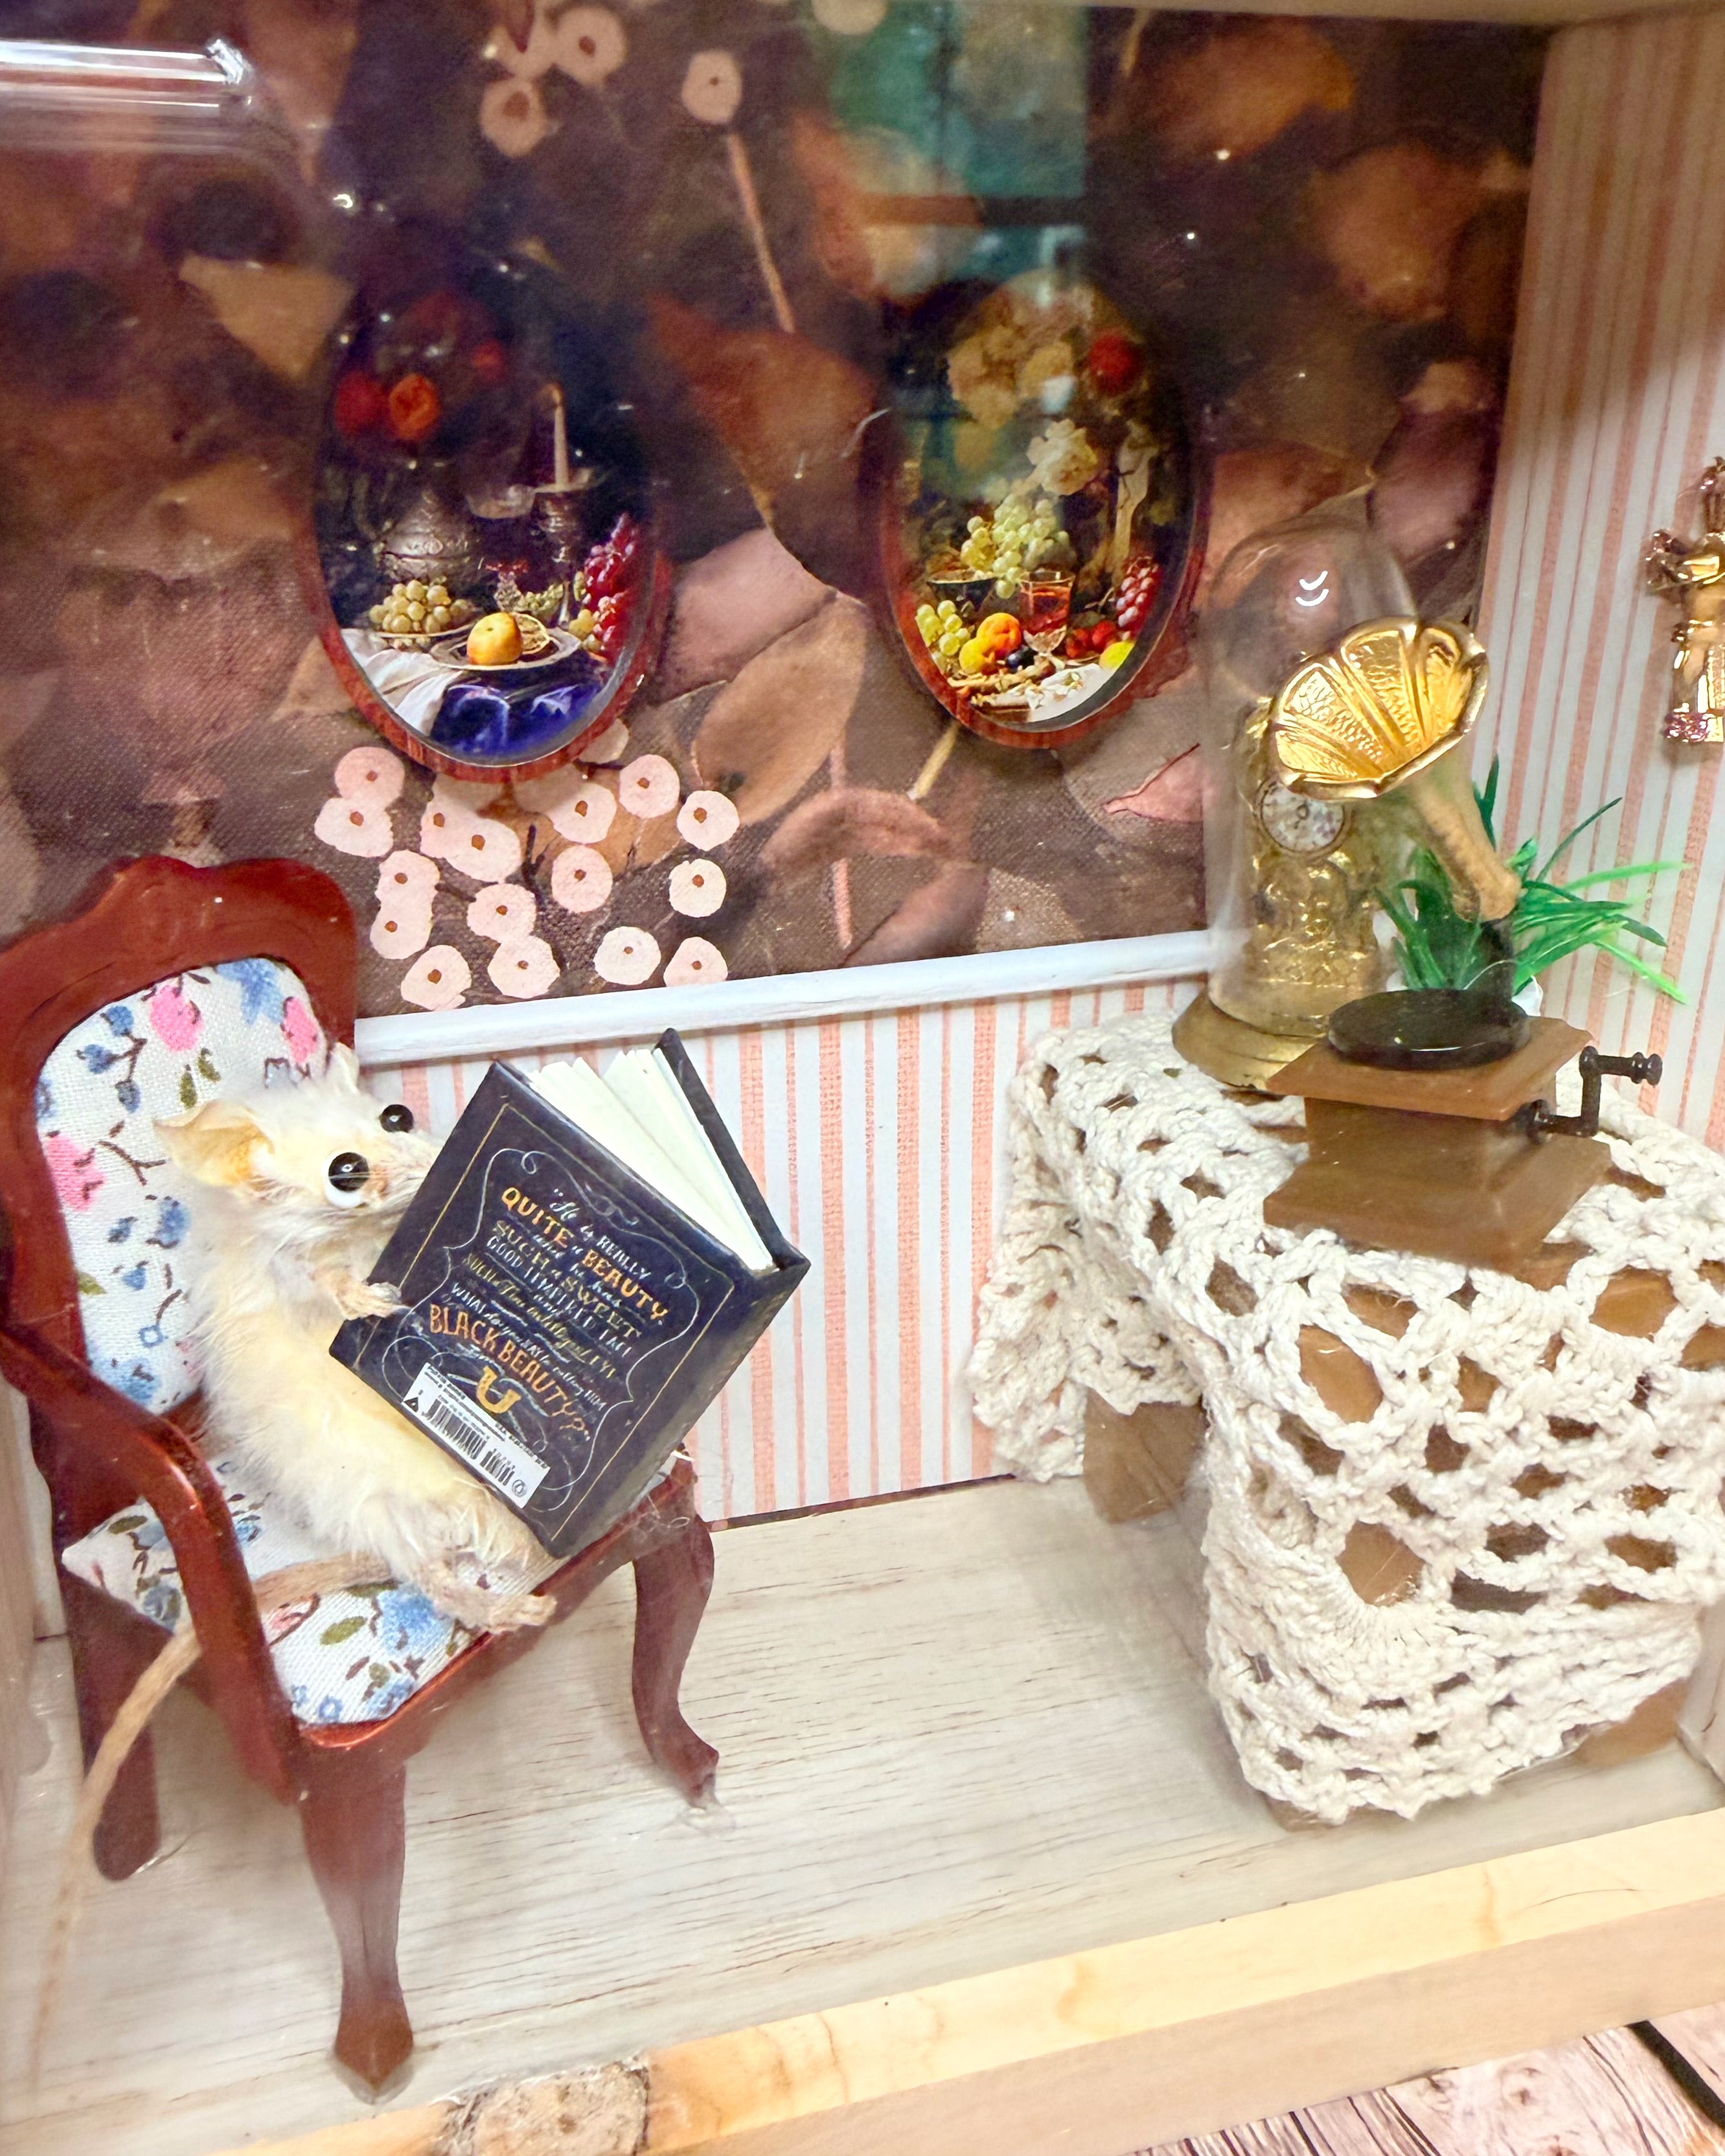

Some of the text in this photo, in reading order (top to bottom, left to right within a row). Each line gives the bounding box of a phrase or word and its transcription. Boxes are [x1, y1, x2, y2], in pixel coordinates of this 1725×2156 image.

[501, 1186, 575, 1249] QUITE
[486, 1235, 522, 1267] GOOD
[595, 1235, 651, 1279] REALLY
[492, 1220, 549, 1270] SUCH
[559, 1276, 641, 1337] SWEET
[429, 1303, 499, 1351] BLACK
